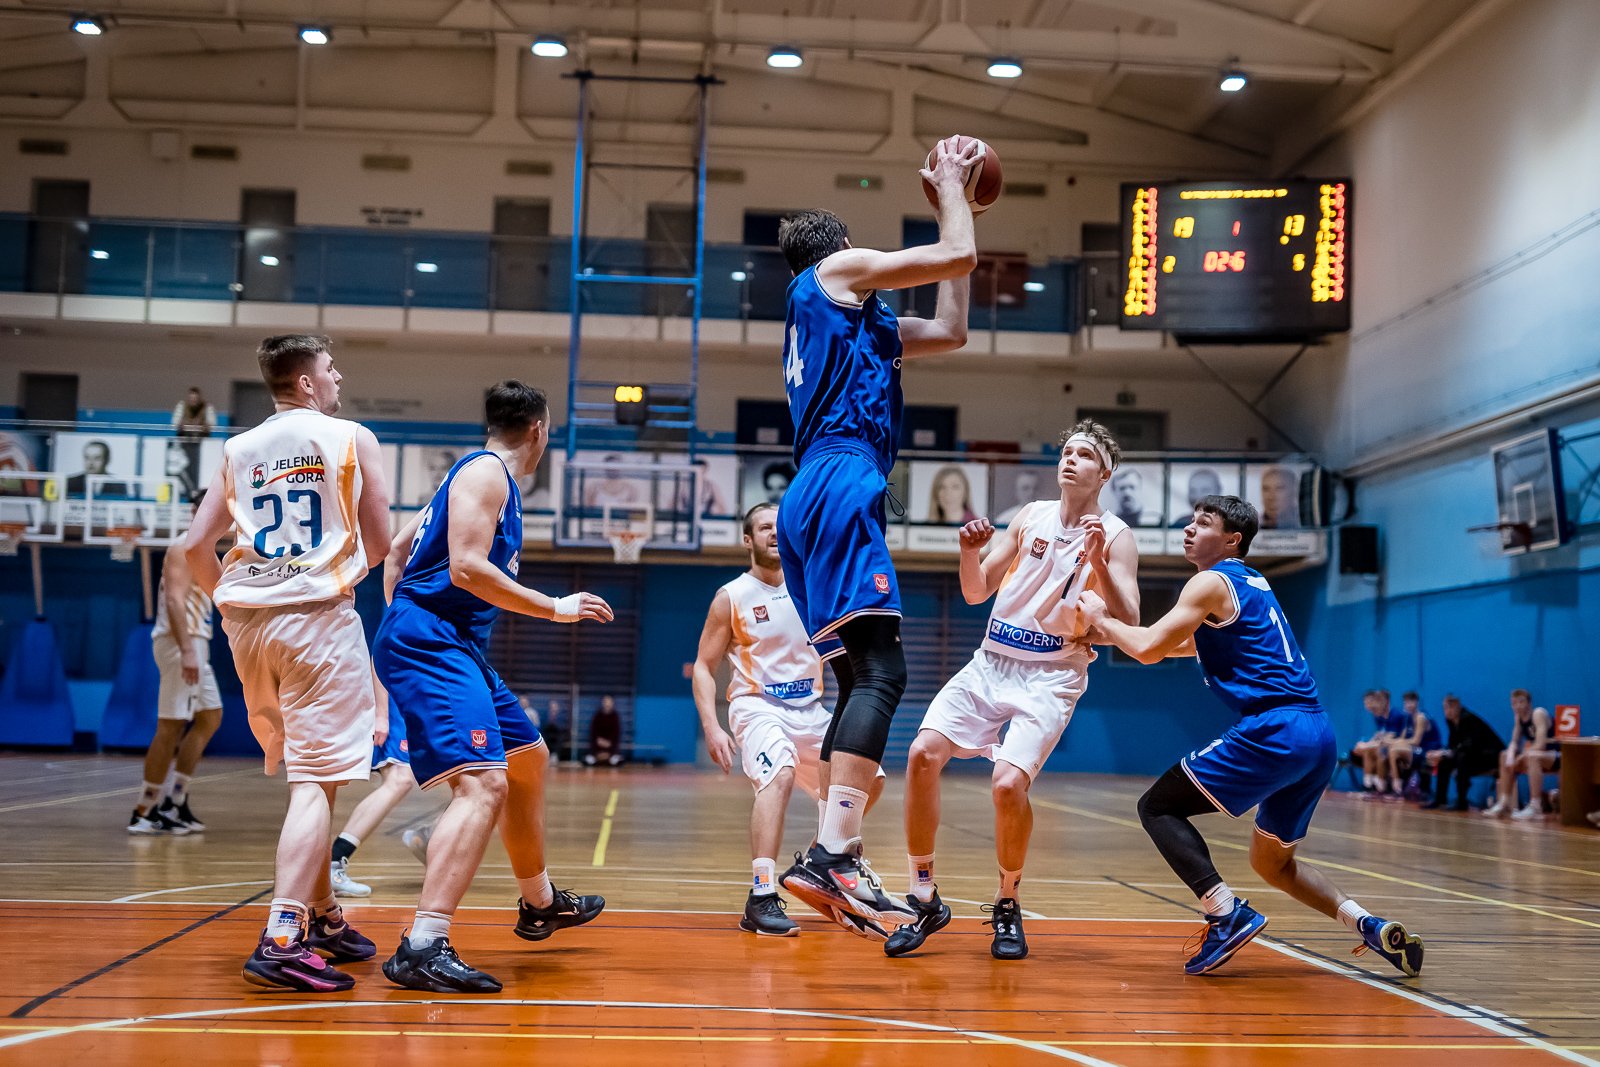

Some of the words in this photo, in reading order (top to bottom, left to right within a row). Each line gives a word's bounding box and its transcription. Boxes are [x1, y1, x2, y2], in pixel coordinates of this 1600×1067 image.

[272, 455, 325, 471] JELENIA
[252, 489, 323, 560] 23
[1000, 624, 1062, 647] MODERN
[1558, 707, 1579, 732] 5
